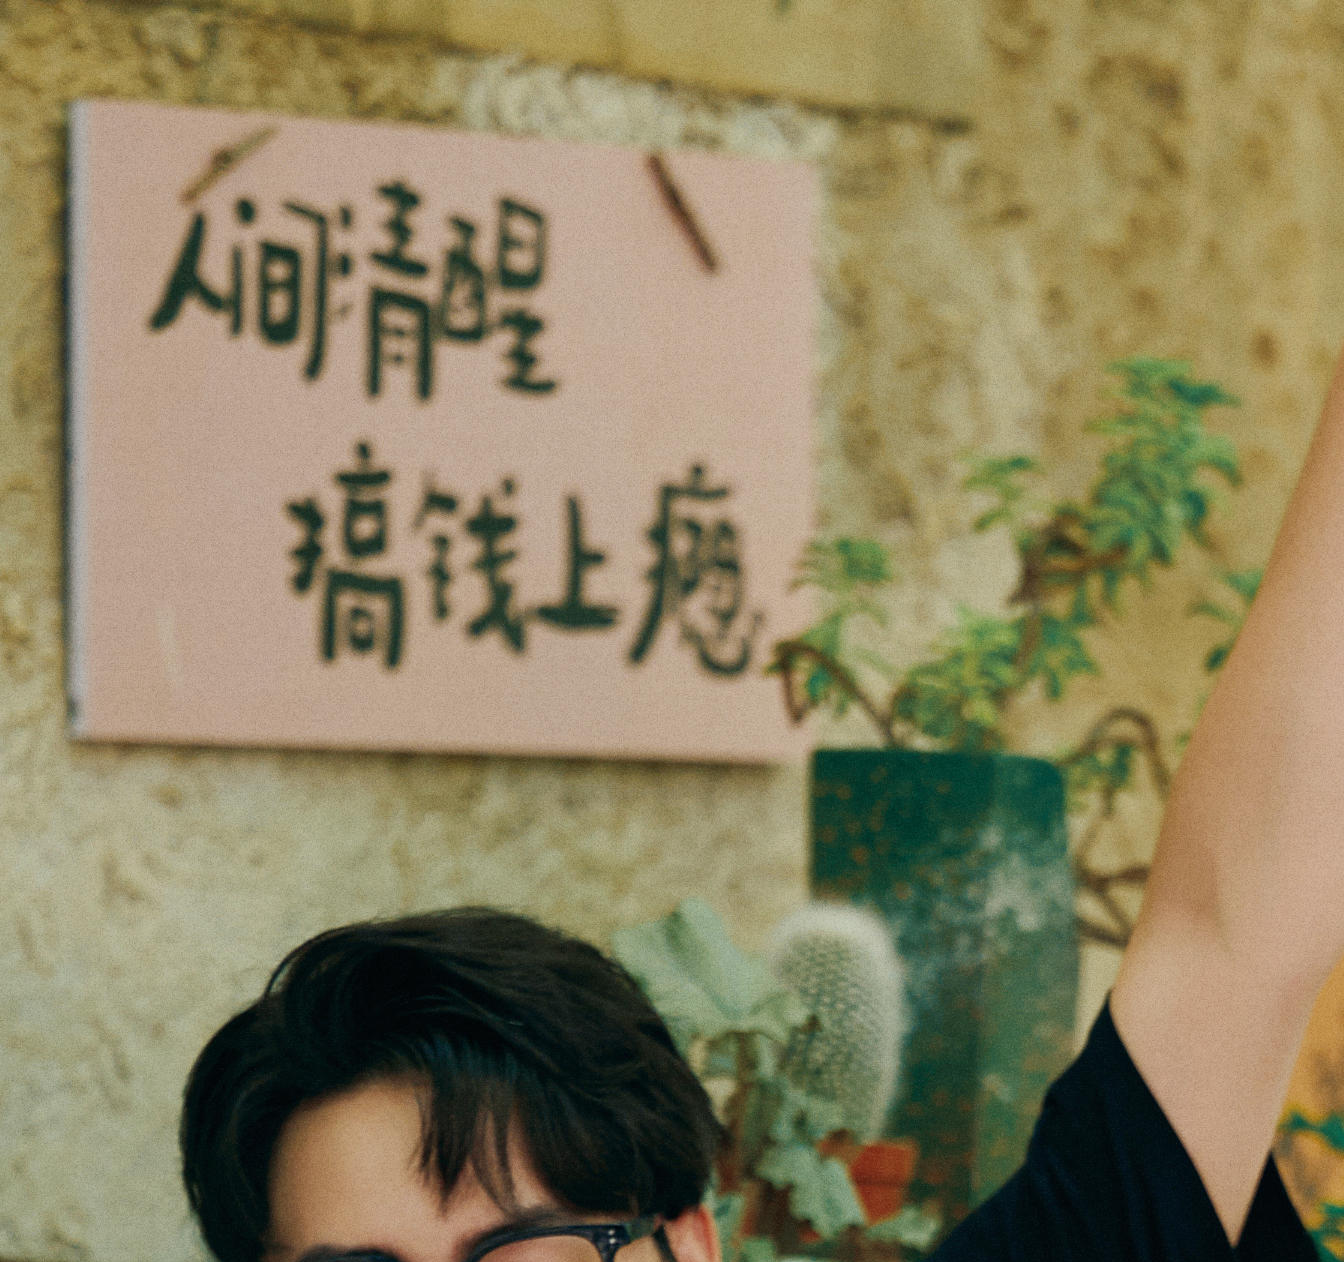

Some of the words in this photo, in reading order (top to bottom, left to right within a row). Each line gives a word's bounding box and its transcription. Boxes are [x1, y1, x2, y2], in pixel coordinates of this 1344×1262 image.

[147, 178, 558, 402] 人间清醒
[286, 439, 760, 679] 搞钱上瘾
